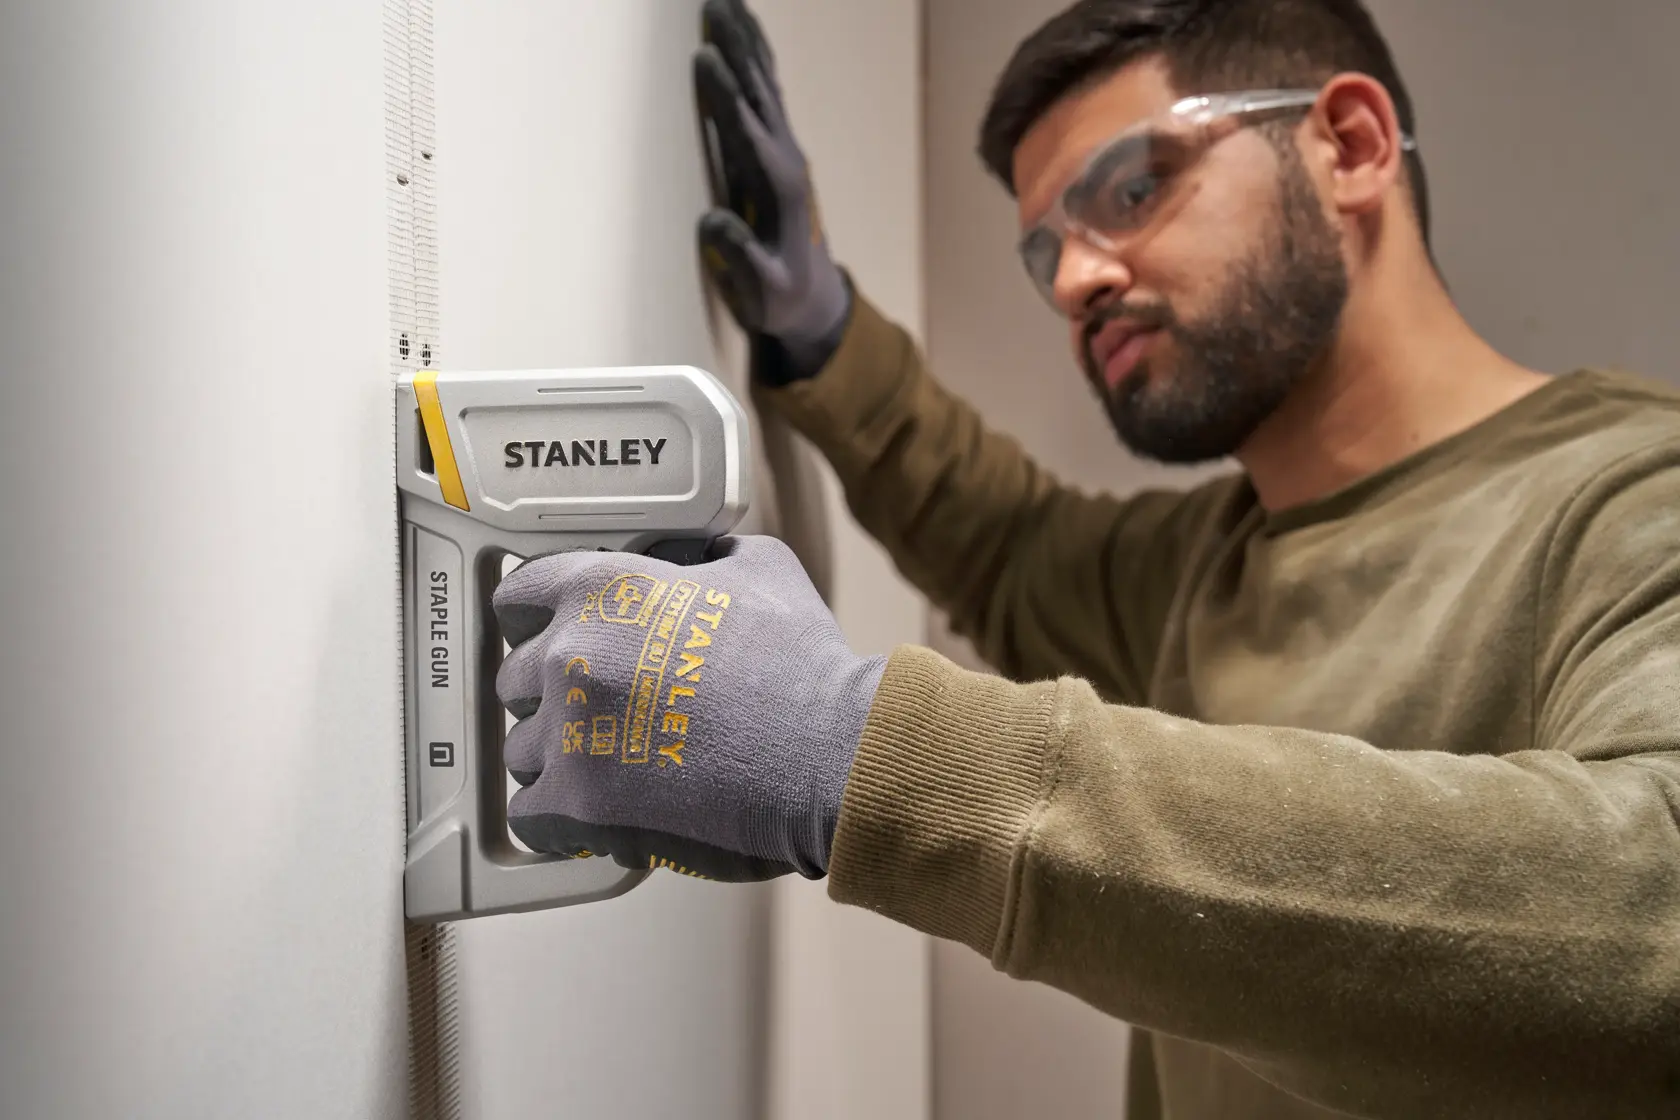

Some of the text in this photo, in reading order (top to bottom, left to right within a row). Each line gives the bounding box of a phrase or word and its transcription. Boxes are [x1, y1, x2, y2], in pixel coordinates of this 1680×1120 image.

[504, 438, 667, 468] STANLEY
[430, 571, 449, 688] STAPLE GUN
[660, 585, 731, 767] STANLEY
